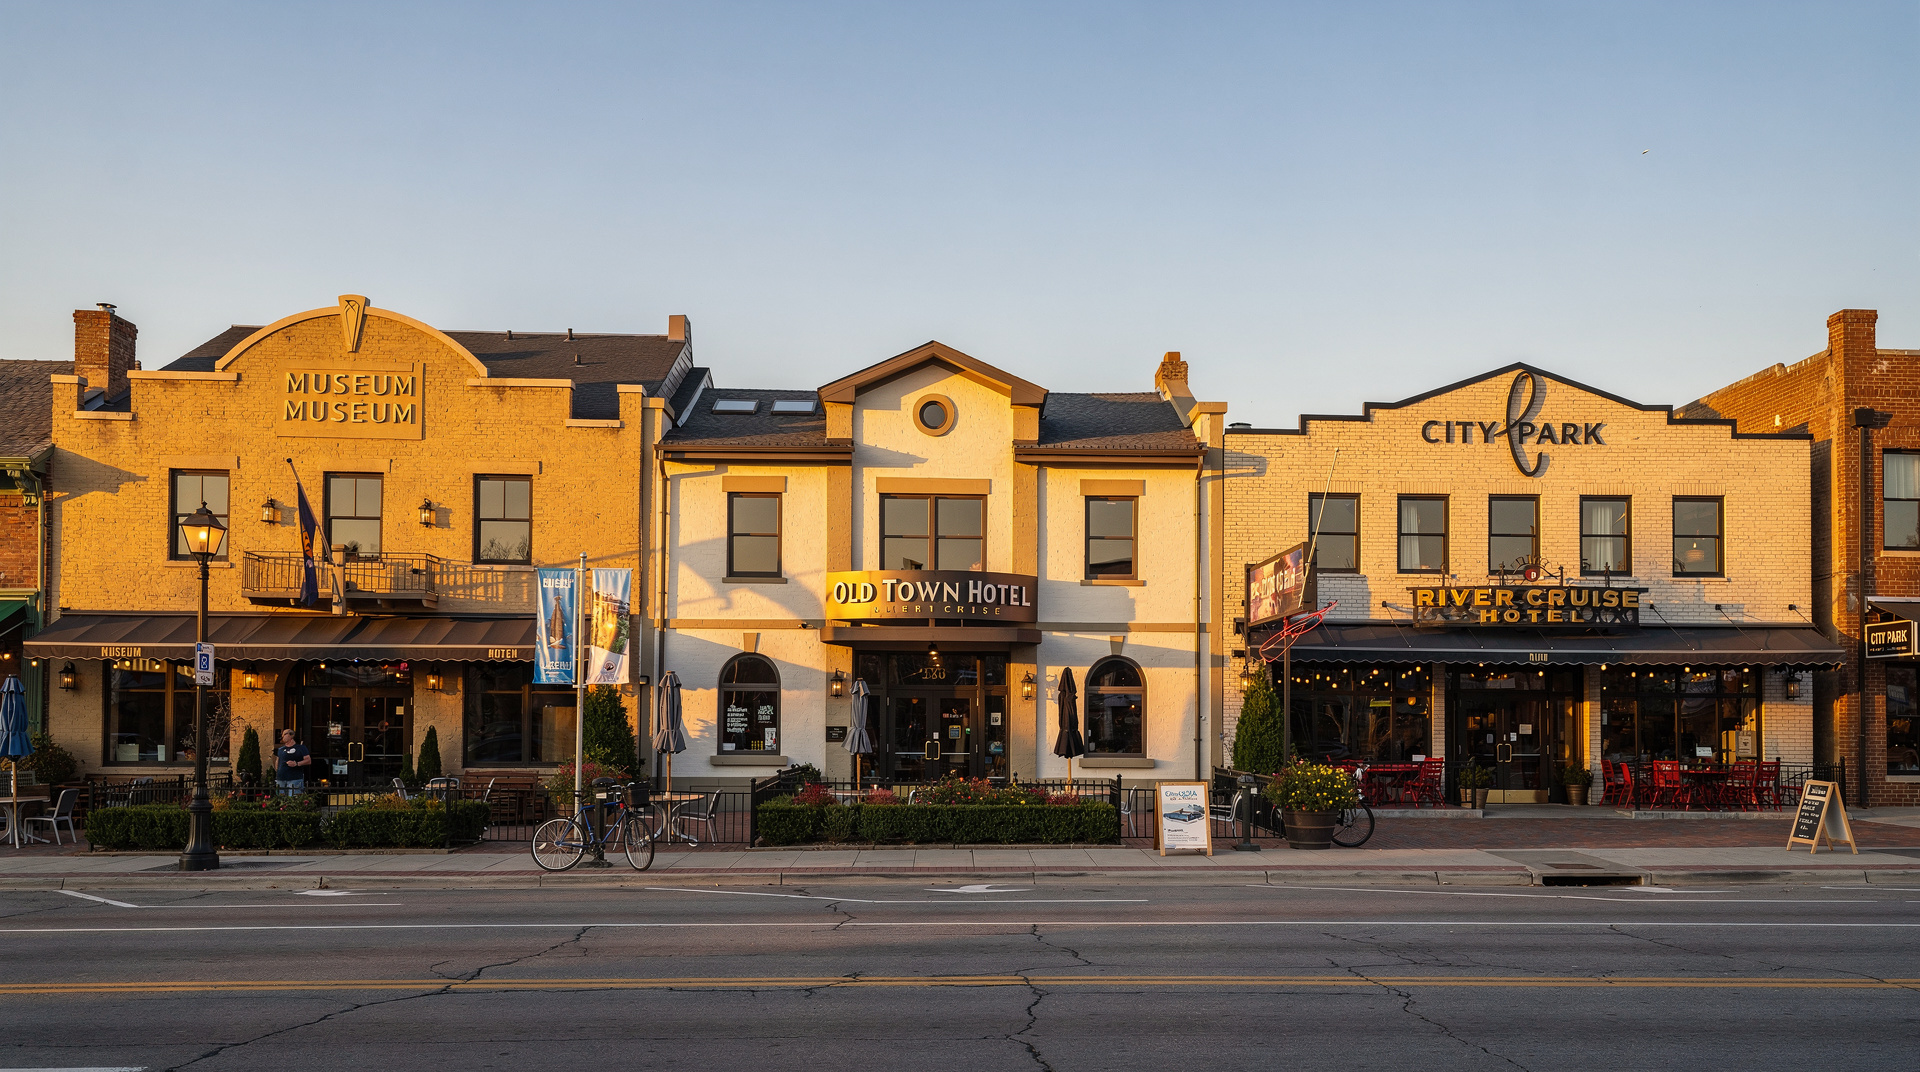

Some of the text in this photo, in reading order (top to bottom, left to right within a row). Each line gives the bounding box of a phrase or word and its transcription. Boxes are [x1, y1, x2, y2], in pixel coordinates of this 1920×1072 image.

[285, 372, 416, 397] MUSEUM
[283, 399, 416, 424] MUSEUM
[1421, 420, 1497, 444] CITY
[1518, 422, 1604, 445] PARK
[833, 579, 1031, 607] OLD TOWN HOTEL
[1416, 589, 1640, 608] RIVER CRUISE
[1480, 609, 1585, 623] HOTEL
[1870, 629, 1908, 645] CITY PARK
